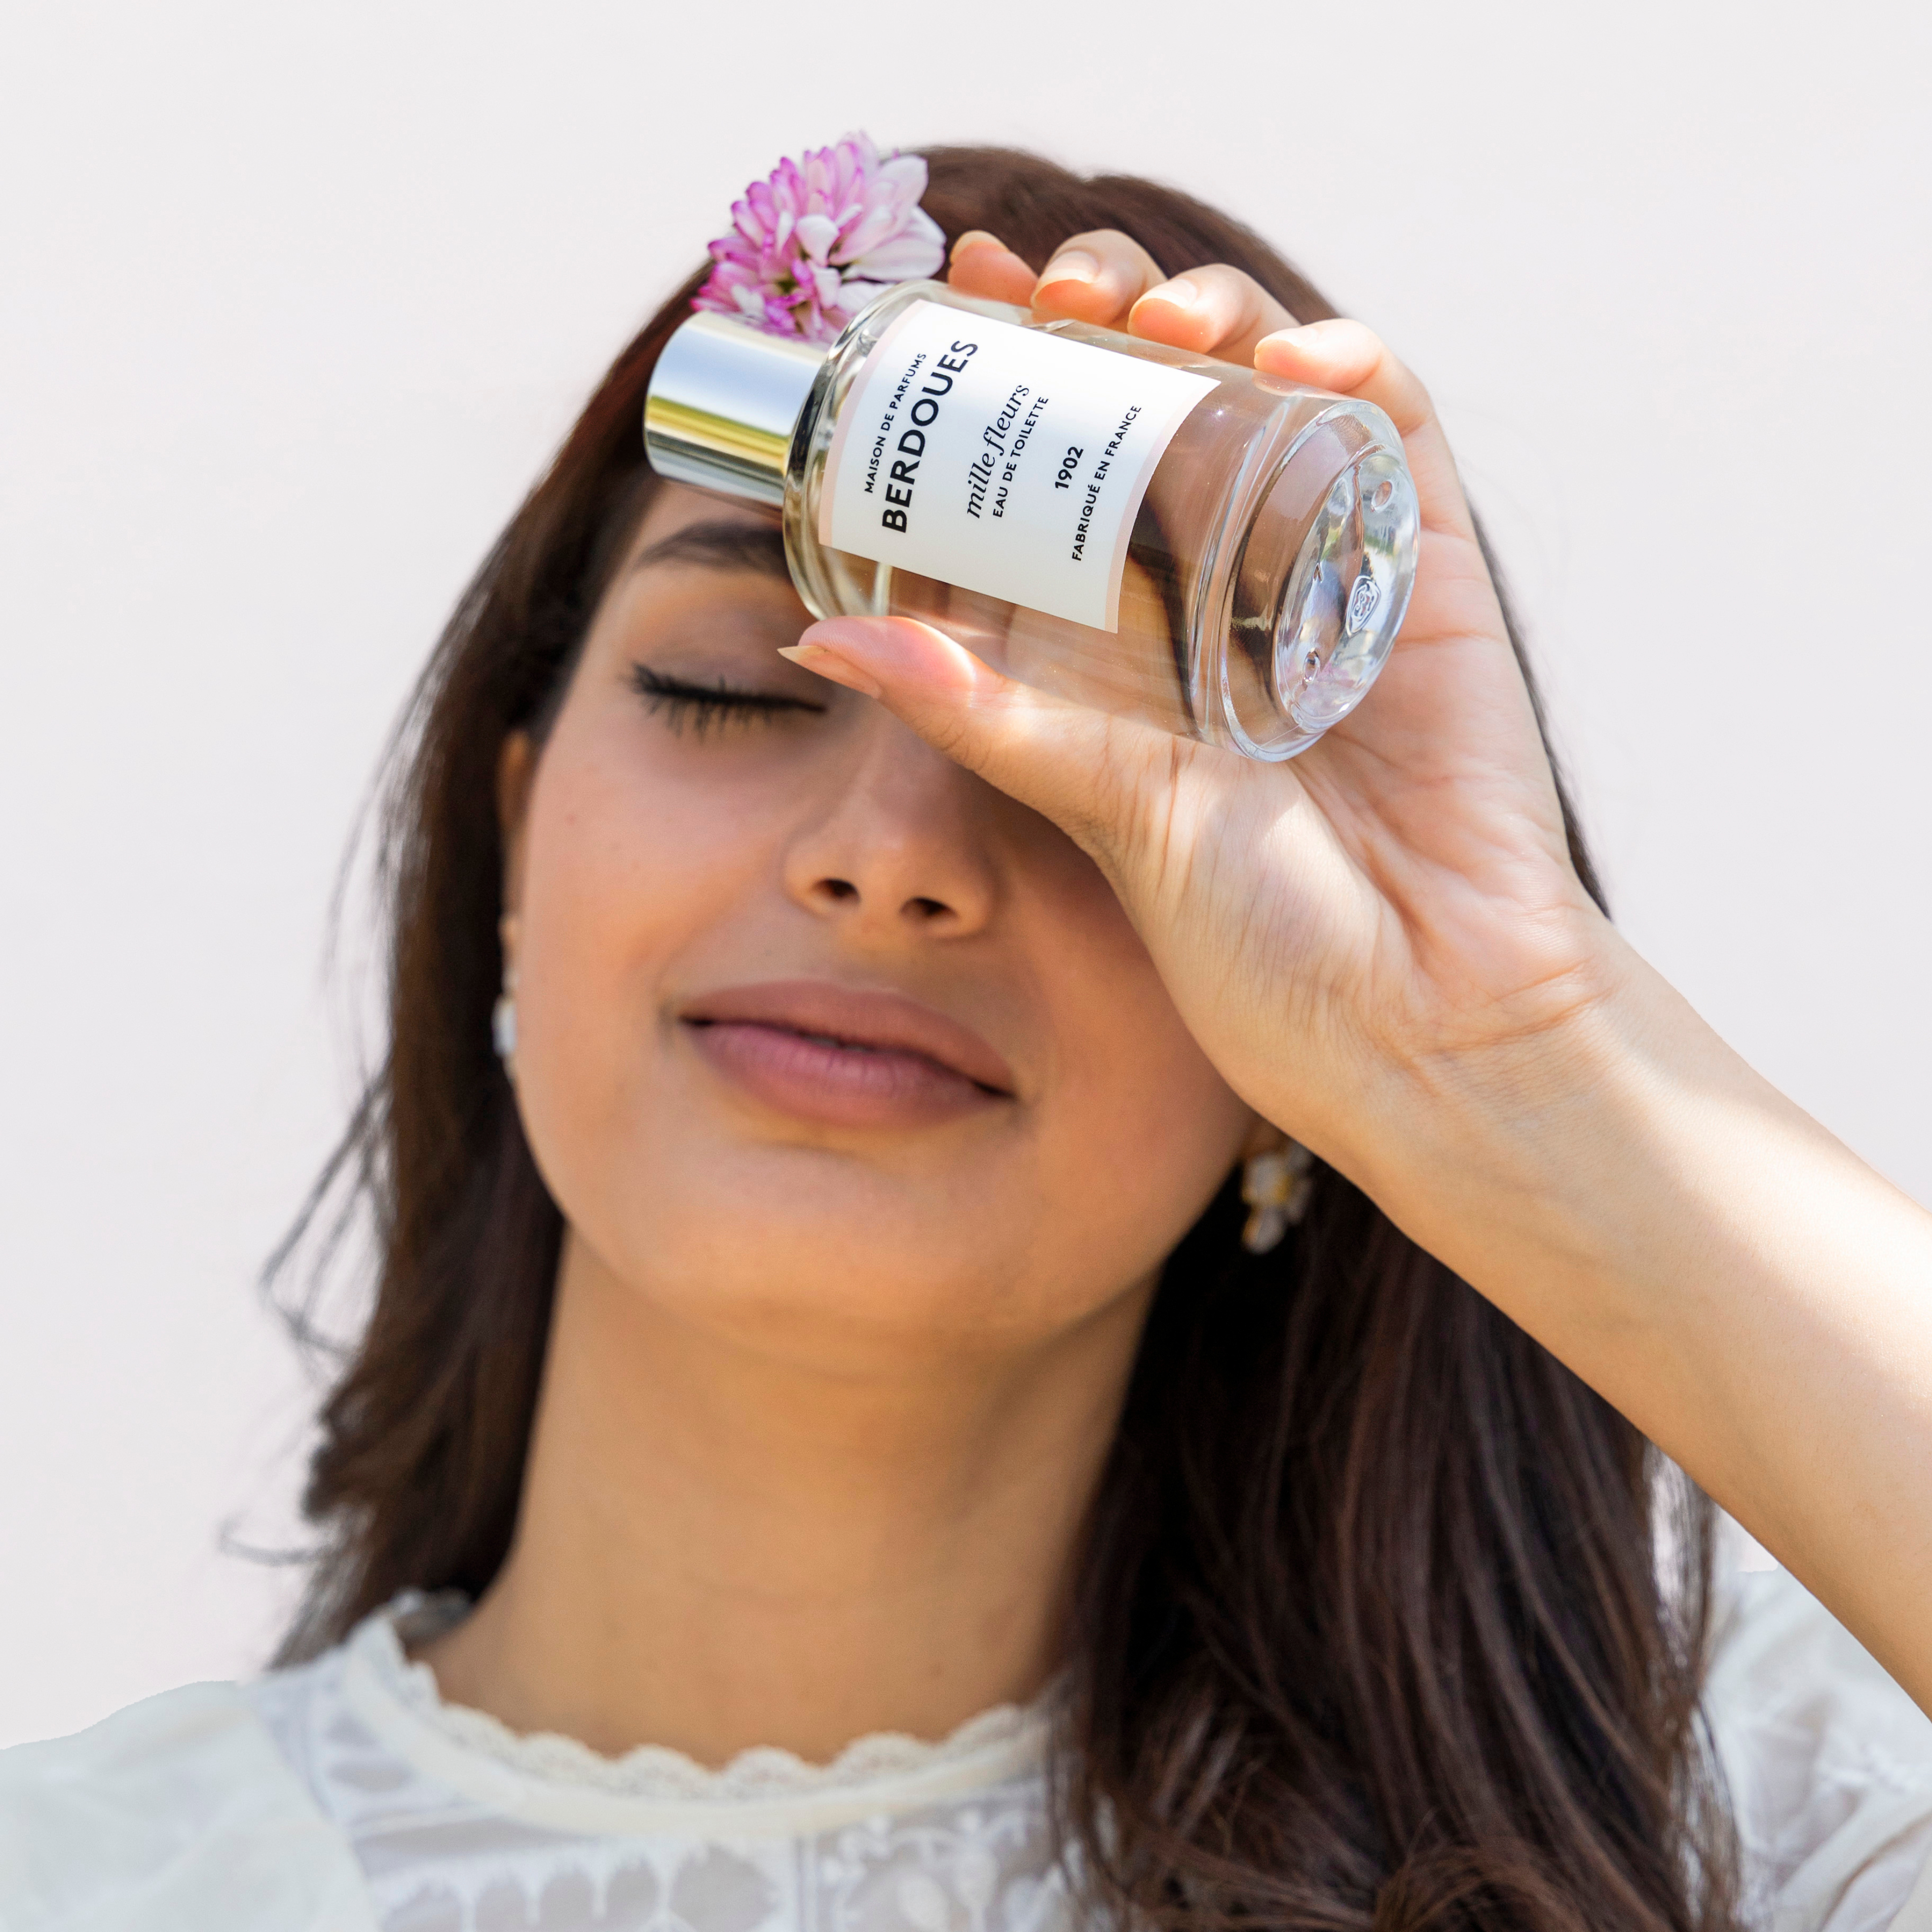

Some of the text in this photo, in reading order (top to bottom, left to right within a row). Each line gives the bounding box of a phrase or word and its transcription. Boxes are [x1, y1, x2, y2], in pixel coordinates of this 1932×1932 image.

[864, 353, 927, 493] MAISON DE PARFUMS
[882, 340, 978, 533] BERDOUES
[966, 385, 1030, 519] mille fleurs
[993, 397, 1049, 518] EAU DE TOILETTE
[1054, 446, 1084, 489] 1902
[1072, 406, 1142, 561] FABRIQUÉ EN FRANCE
